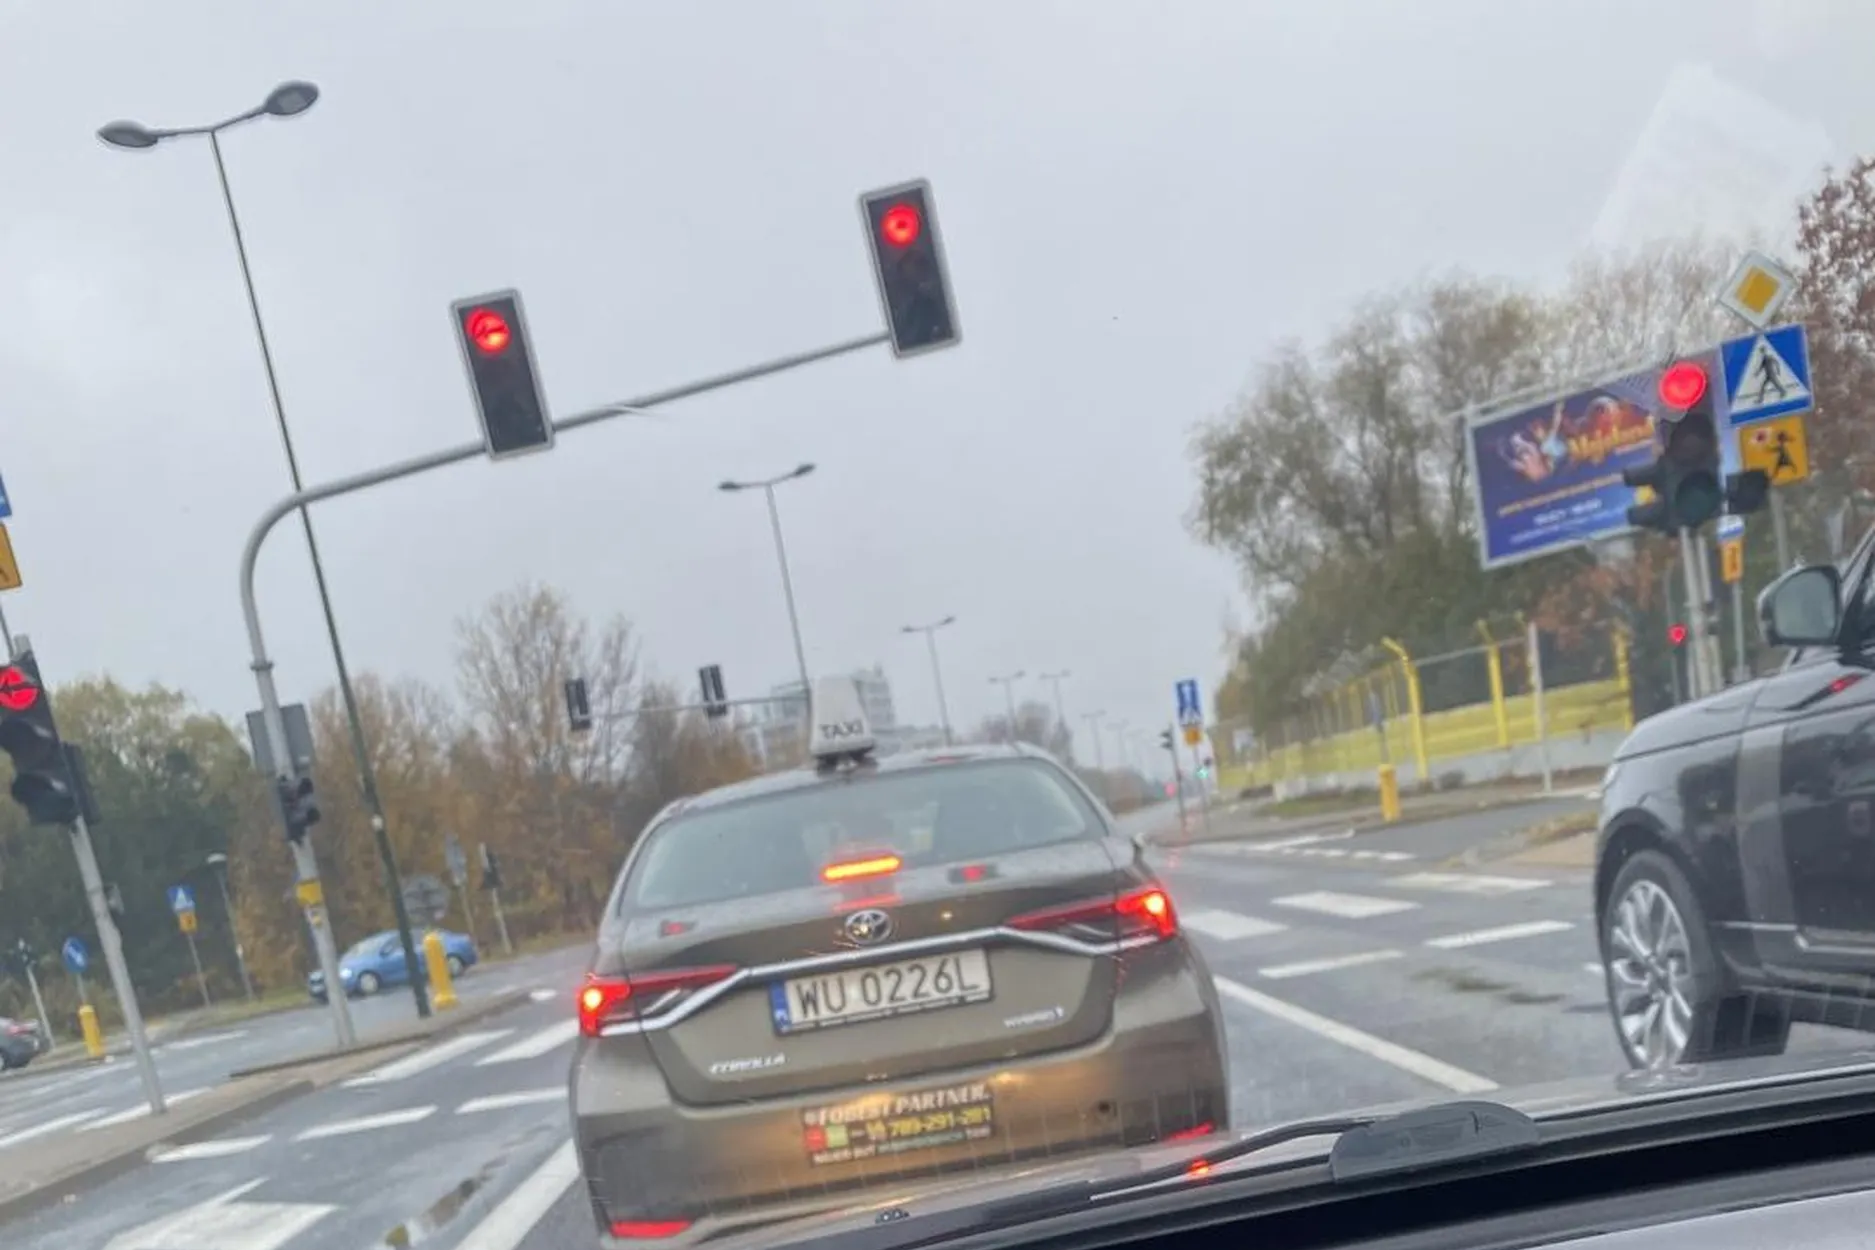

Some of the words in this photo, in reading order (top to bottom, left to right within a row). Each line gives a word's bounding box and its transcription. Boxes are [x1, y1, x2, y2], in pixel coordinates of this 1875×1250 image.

[819, 719, 864, 740] TAXI
[796, 977, 848, 1019] WU
[860, 957, 981, 1007] 0226L
